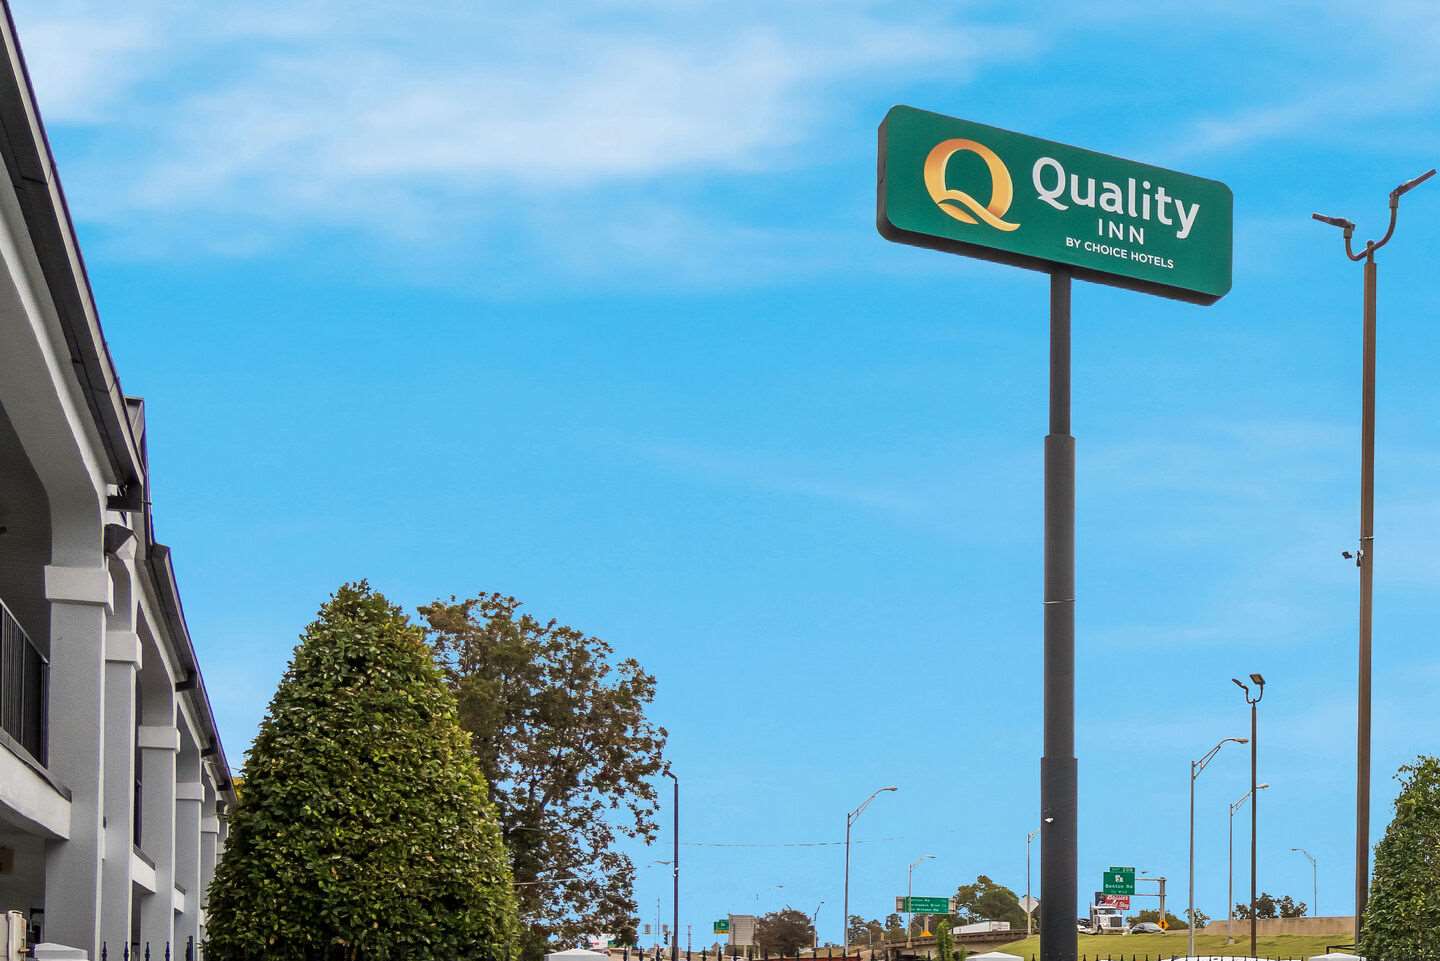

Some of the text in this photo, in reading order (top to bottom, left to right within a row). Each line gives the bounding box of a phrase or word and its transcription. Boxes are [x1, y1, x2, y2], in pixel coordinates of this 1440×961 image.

[924, 138, 1021, 232] Q
[1032, 156, 1200, 239] Quality
[1065, 237, 1175, 269] BY CHOICE HOTELS
[1098, 218, 1144, 245] INN
